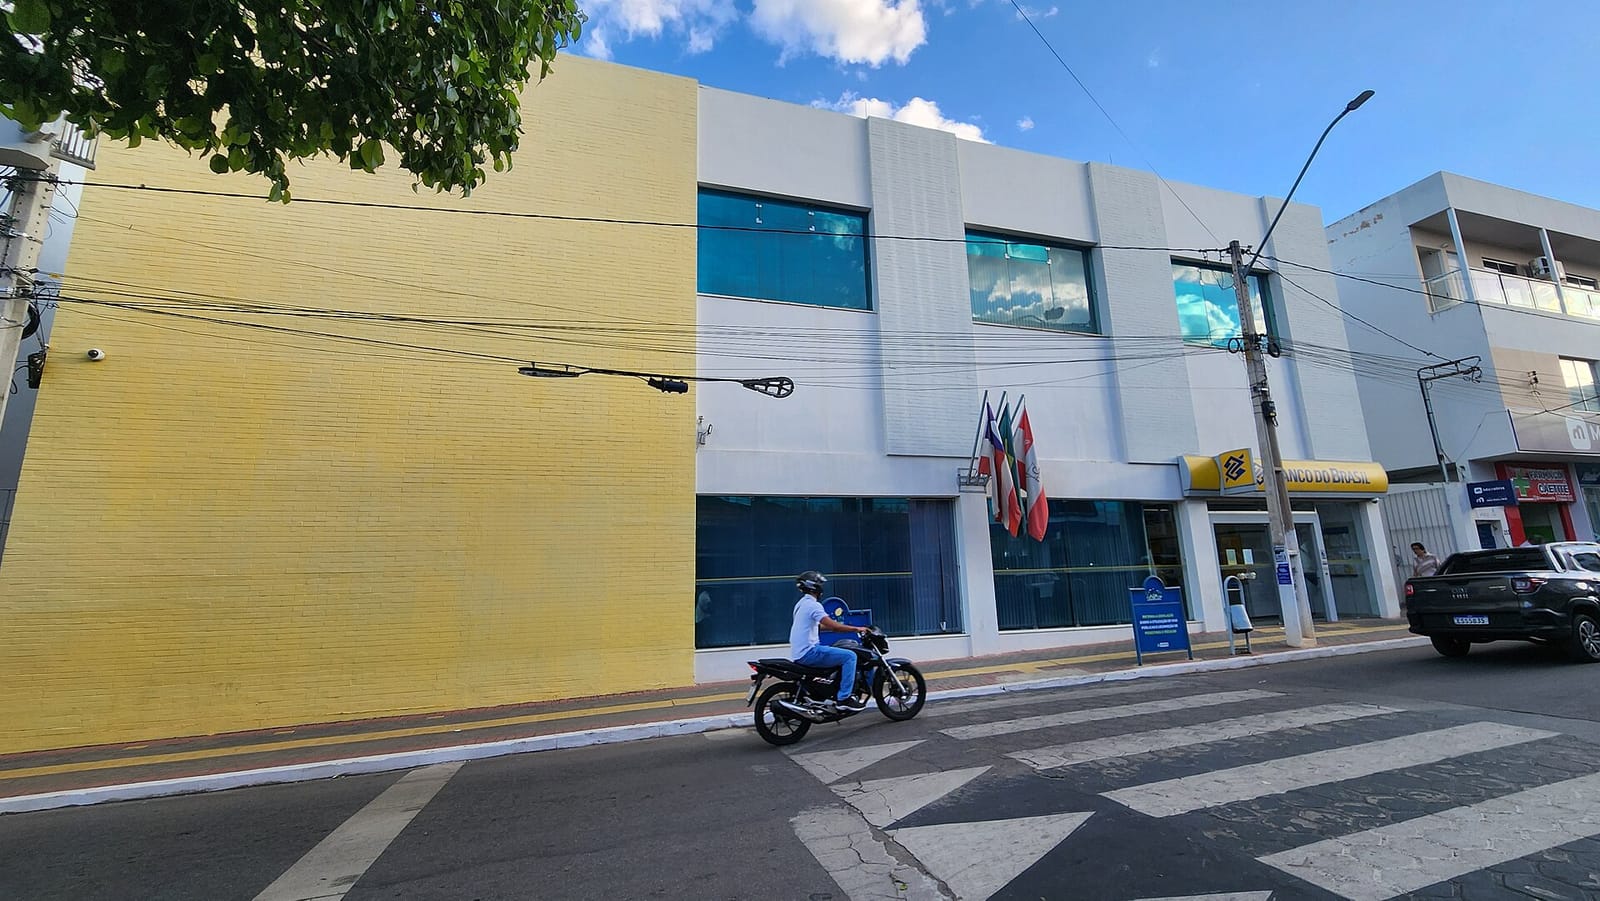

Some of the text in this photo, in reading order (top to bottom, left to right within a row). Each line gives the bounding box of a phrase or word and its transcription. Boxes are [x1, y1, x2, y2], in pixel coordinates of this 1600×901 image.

[1282, 468, 1371, 485] ANCO DO BRASIL
